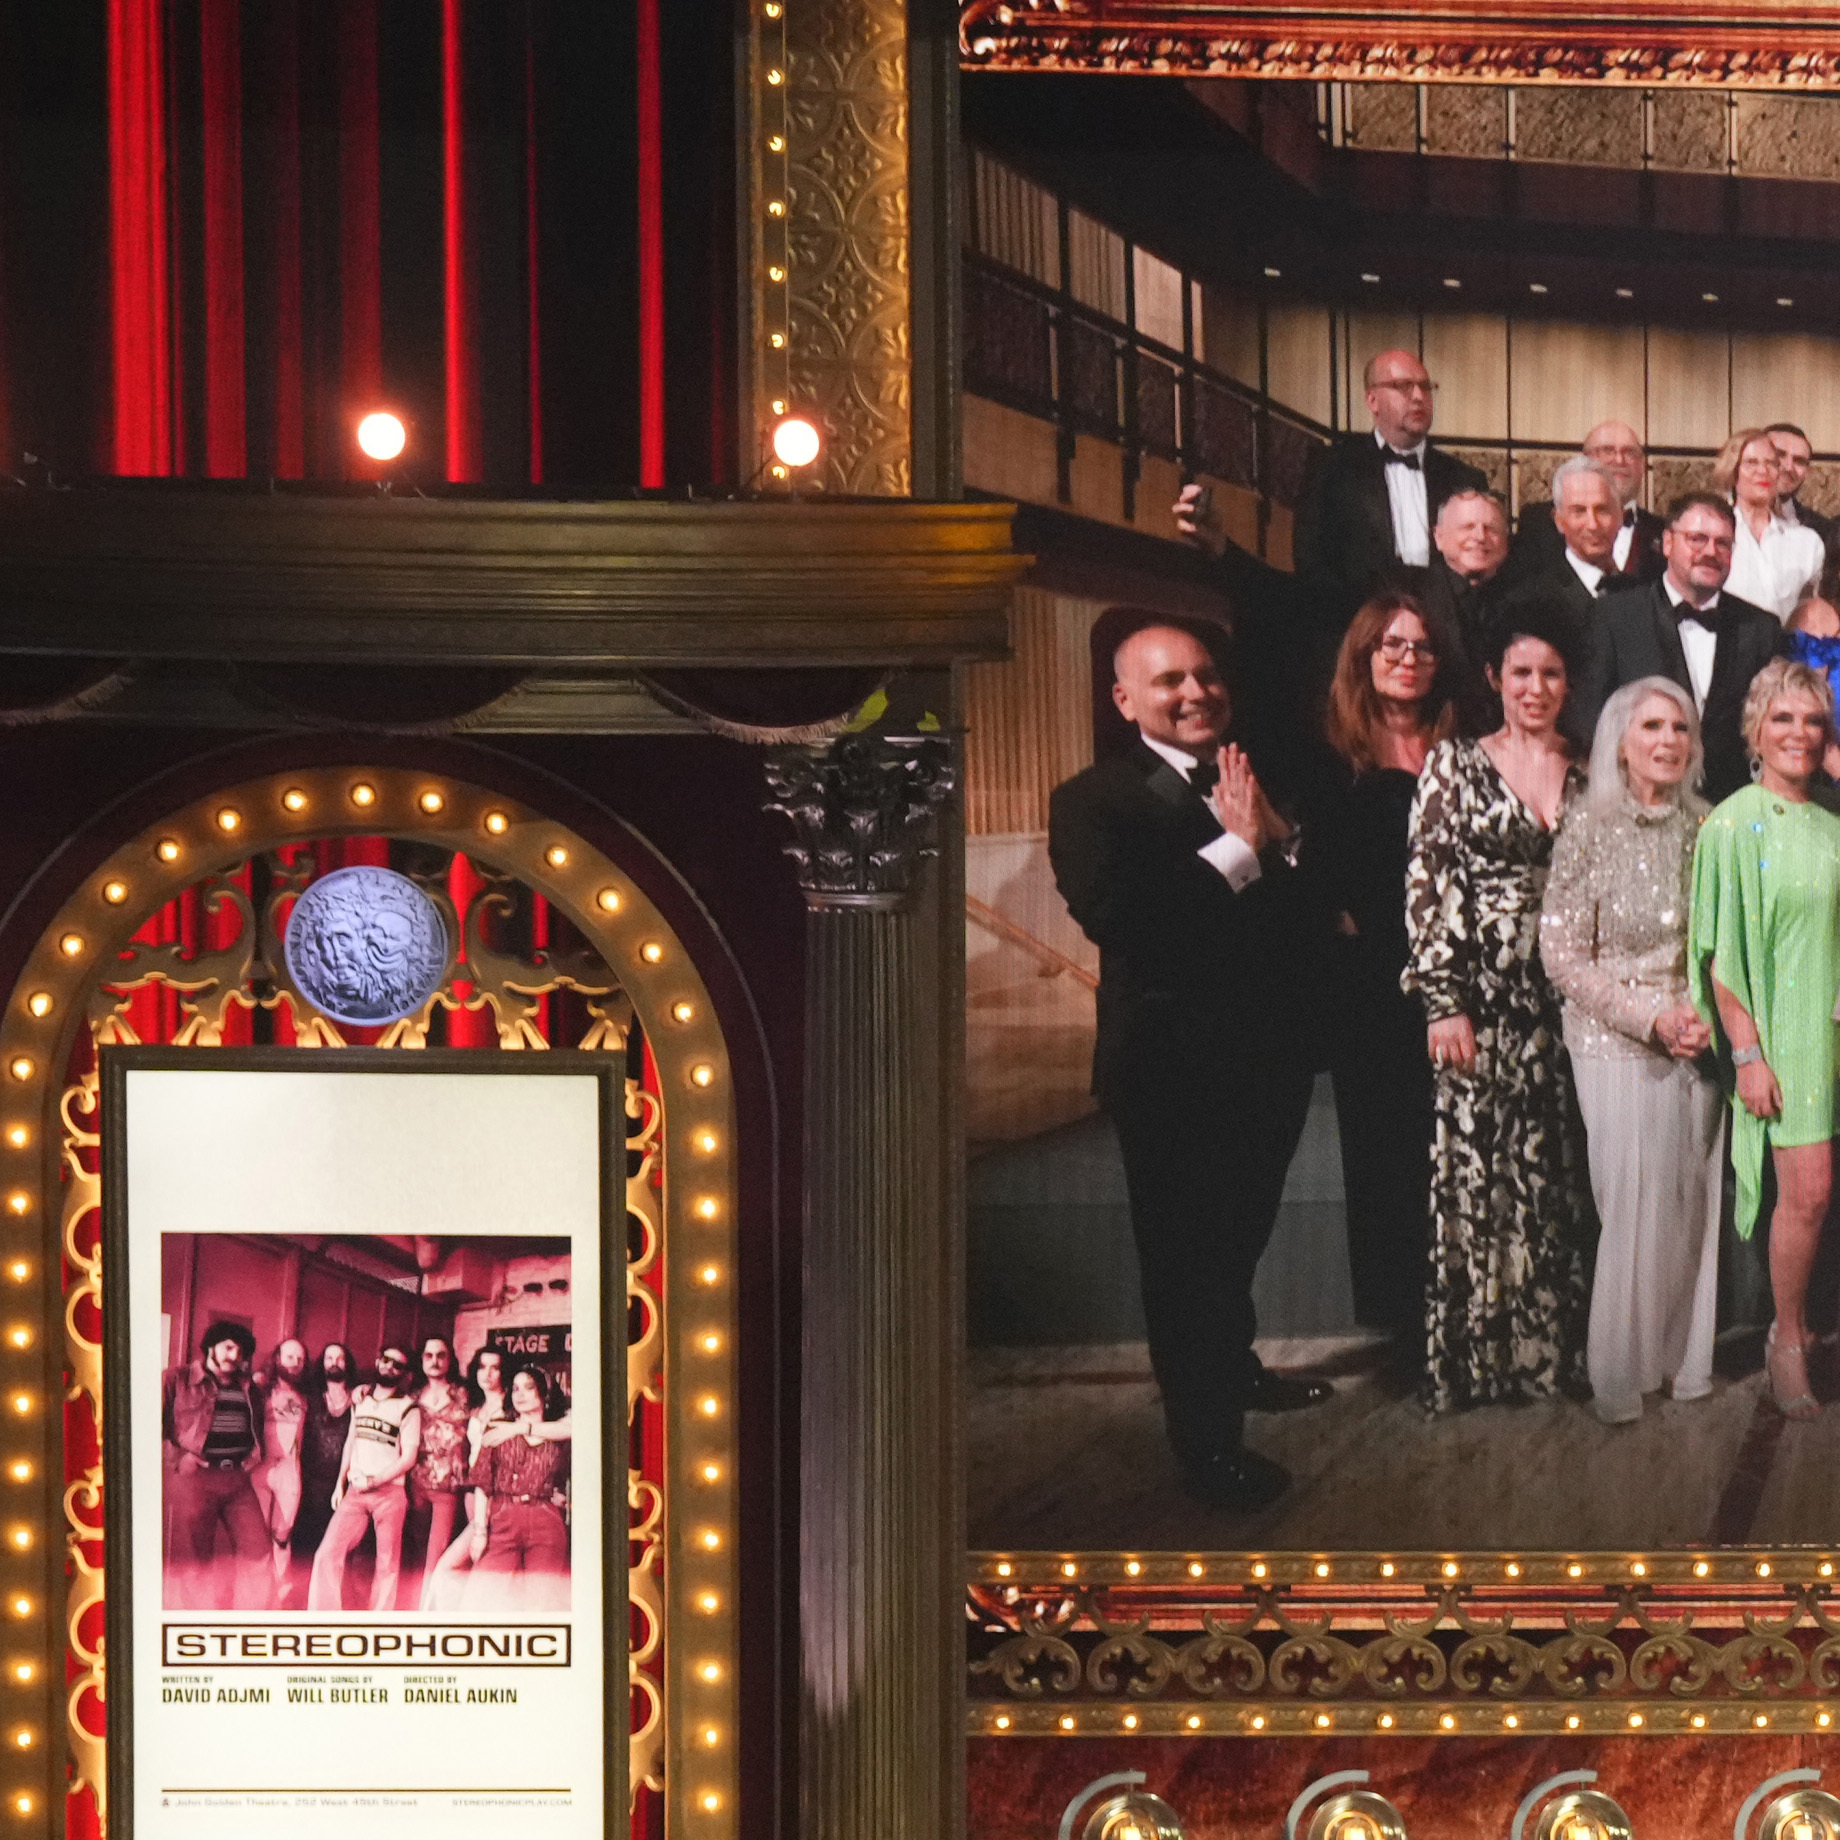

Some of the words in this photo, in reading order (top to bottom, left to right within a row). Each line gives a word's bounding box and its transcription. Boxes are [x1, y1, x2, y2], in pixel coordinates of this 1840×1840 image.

[176, 1633, 558, 1658] STEREOPHONIC
[162, 1688, 211, 1703] DAVID
[217, 1688, 270, 1703] ADJMI
[288, 1688, 323, 1703] WILL
[331, 1688, 388, 1703] BUTLER
[404, 1688, 460, 1703] DANIEL
[467, 1688, 518, 1703] AUKIN
